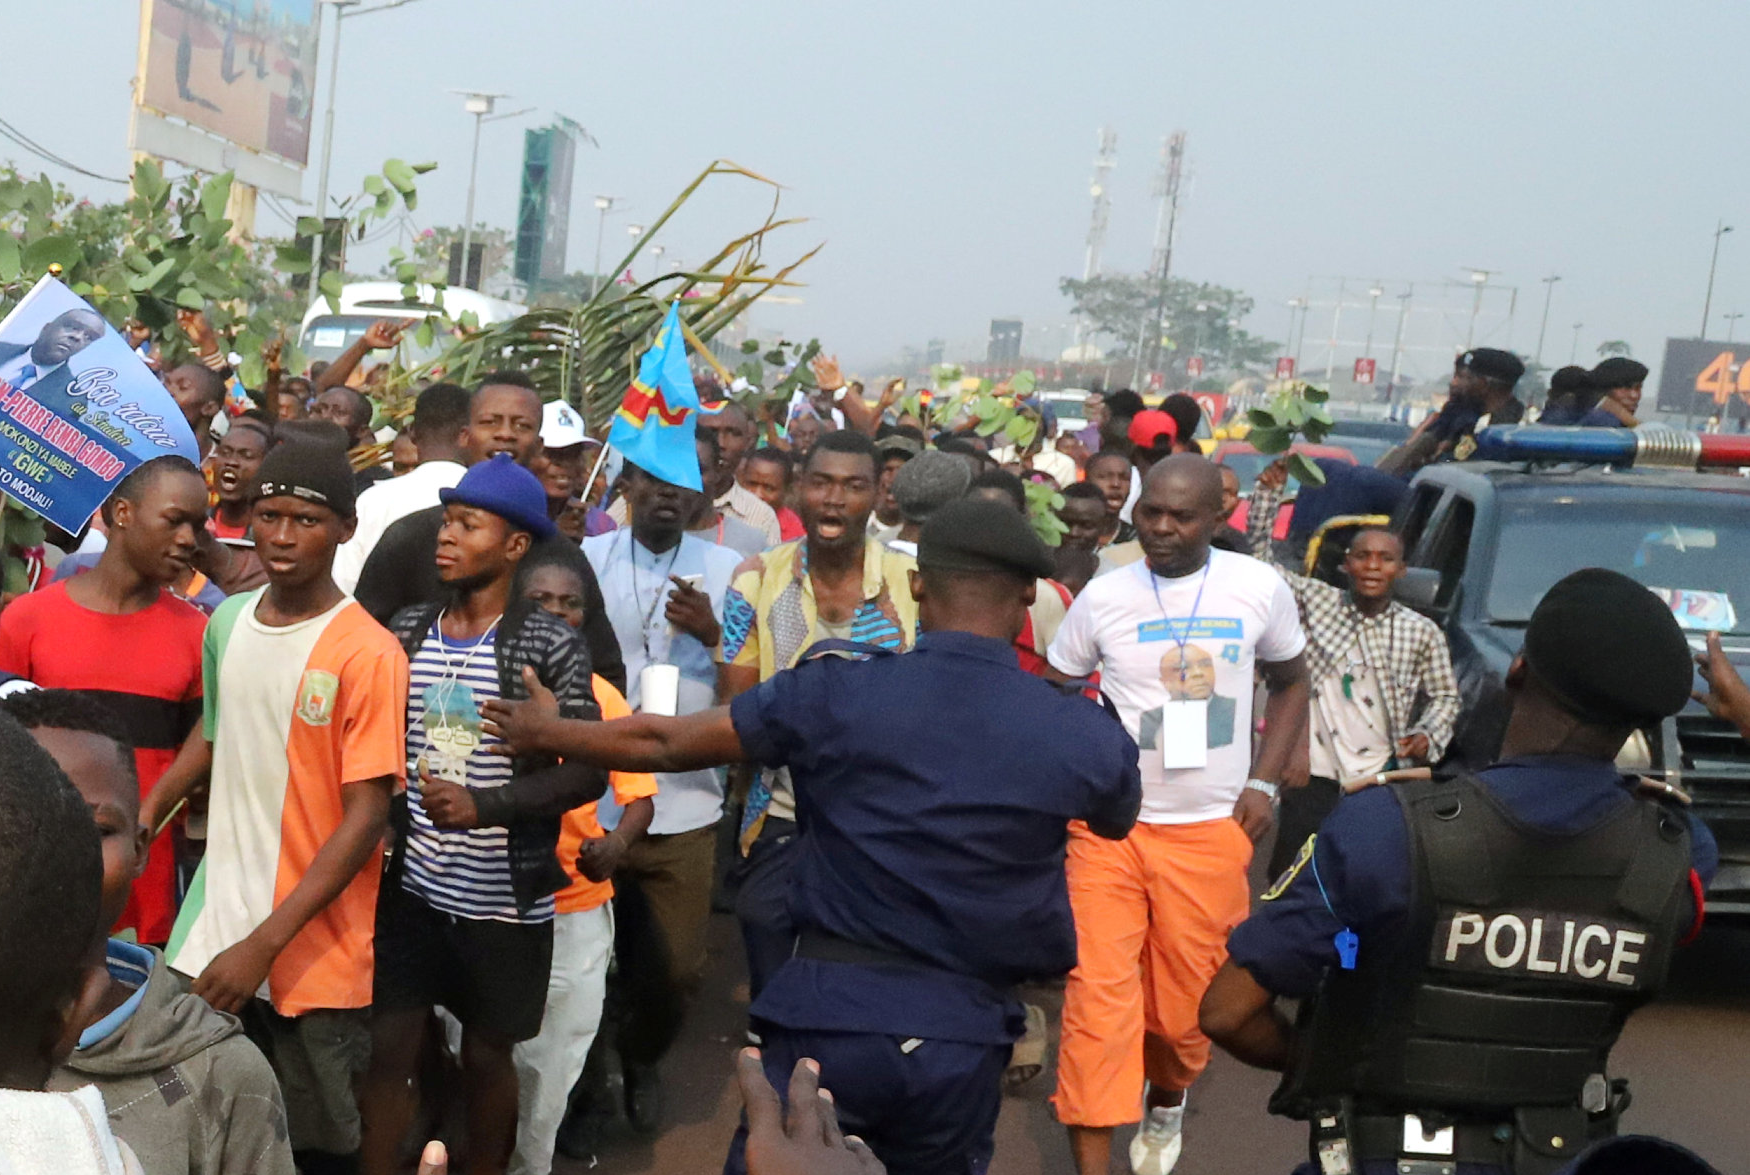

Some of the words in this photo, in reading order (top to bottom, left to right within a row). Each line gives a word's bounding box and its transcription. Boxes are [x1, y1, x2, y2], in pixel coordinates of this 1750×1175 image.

[66, 367, 122, 407] Bon
[113, 402, 178, 448] retour
[12, 452, 49, 482] IGWE
[41, 415, 88, 458] BEMBA
[76, 440, 125, 482] GOMBO
[1445, 911, 1646, 986] POLICE
